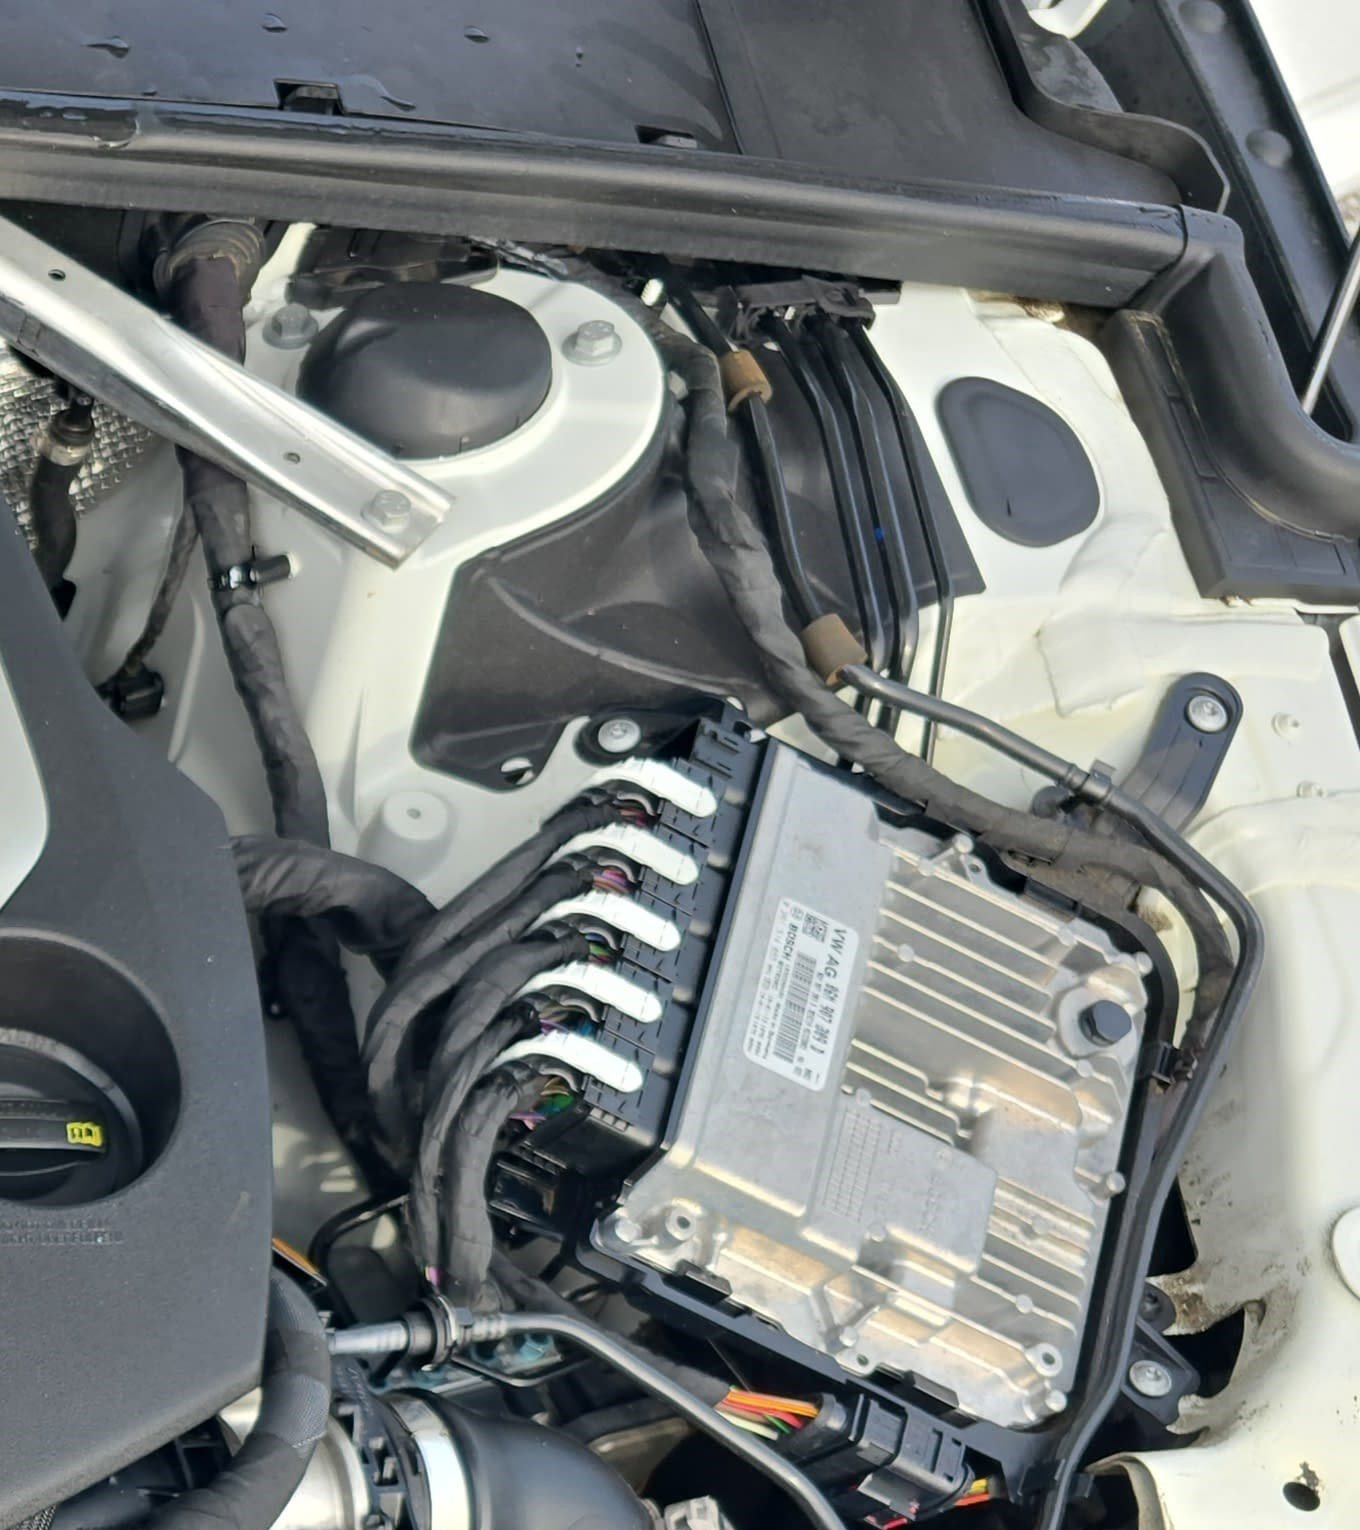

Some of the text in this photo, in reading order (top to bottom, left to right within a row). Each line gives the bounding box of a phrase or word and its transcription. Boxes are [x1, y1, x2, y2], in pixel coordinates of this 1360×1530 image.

[781, 922, 798, 962] BOSCH
[828, 924, 846, 955] VW
[823, 954, 840, 980] AG
